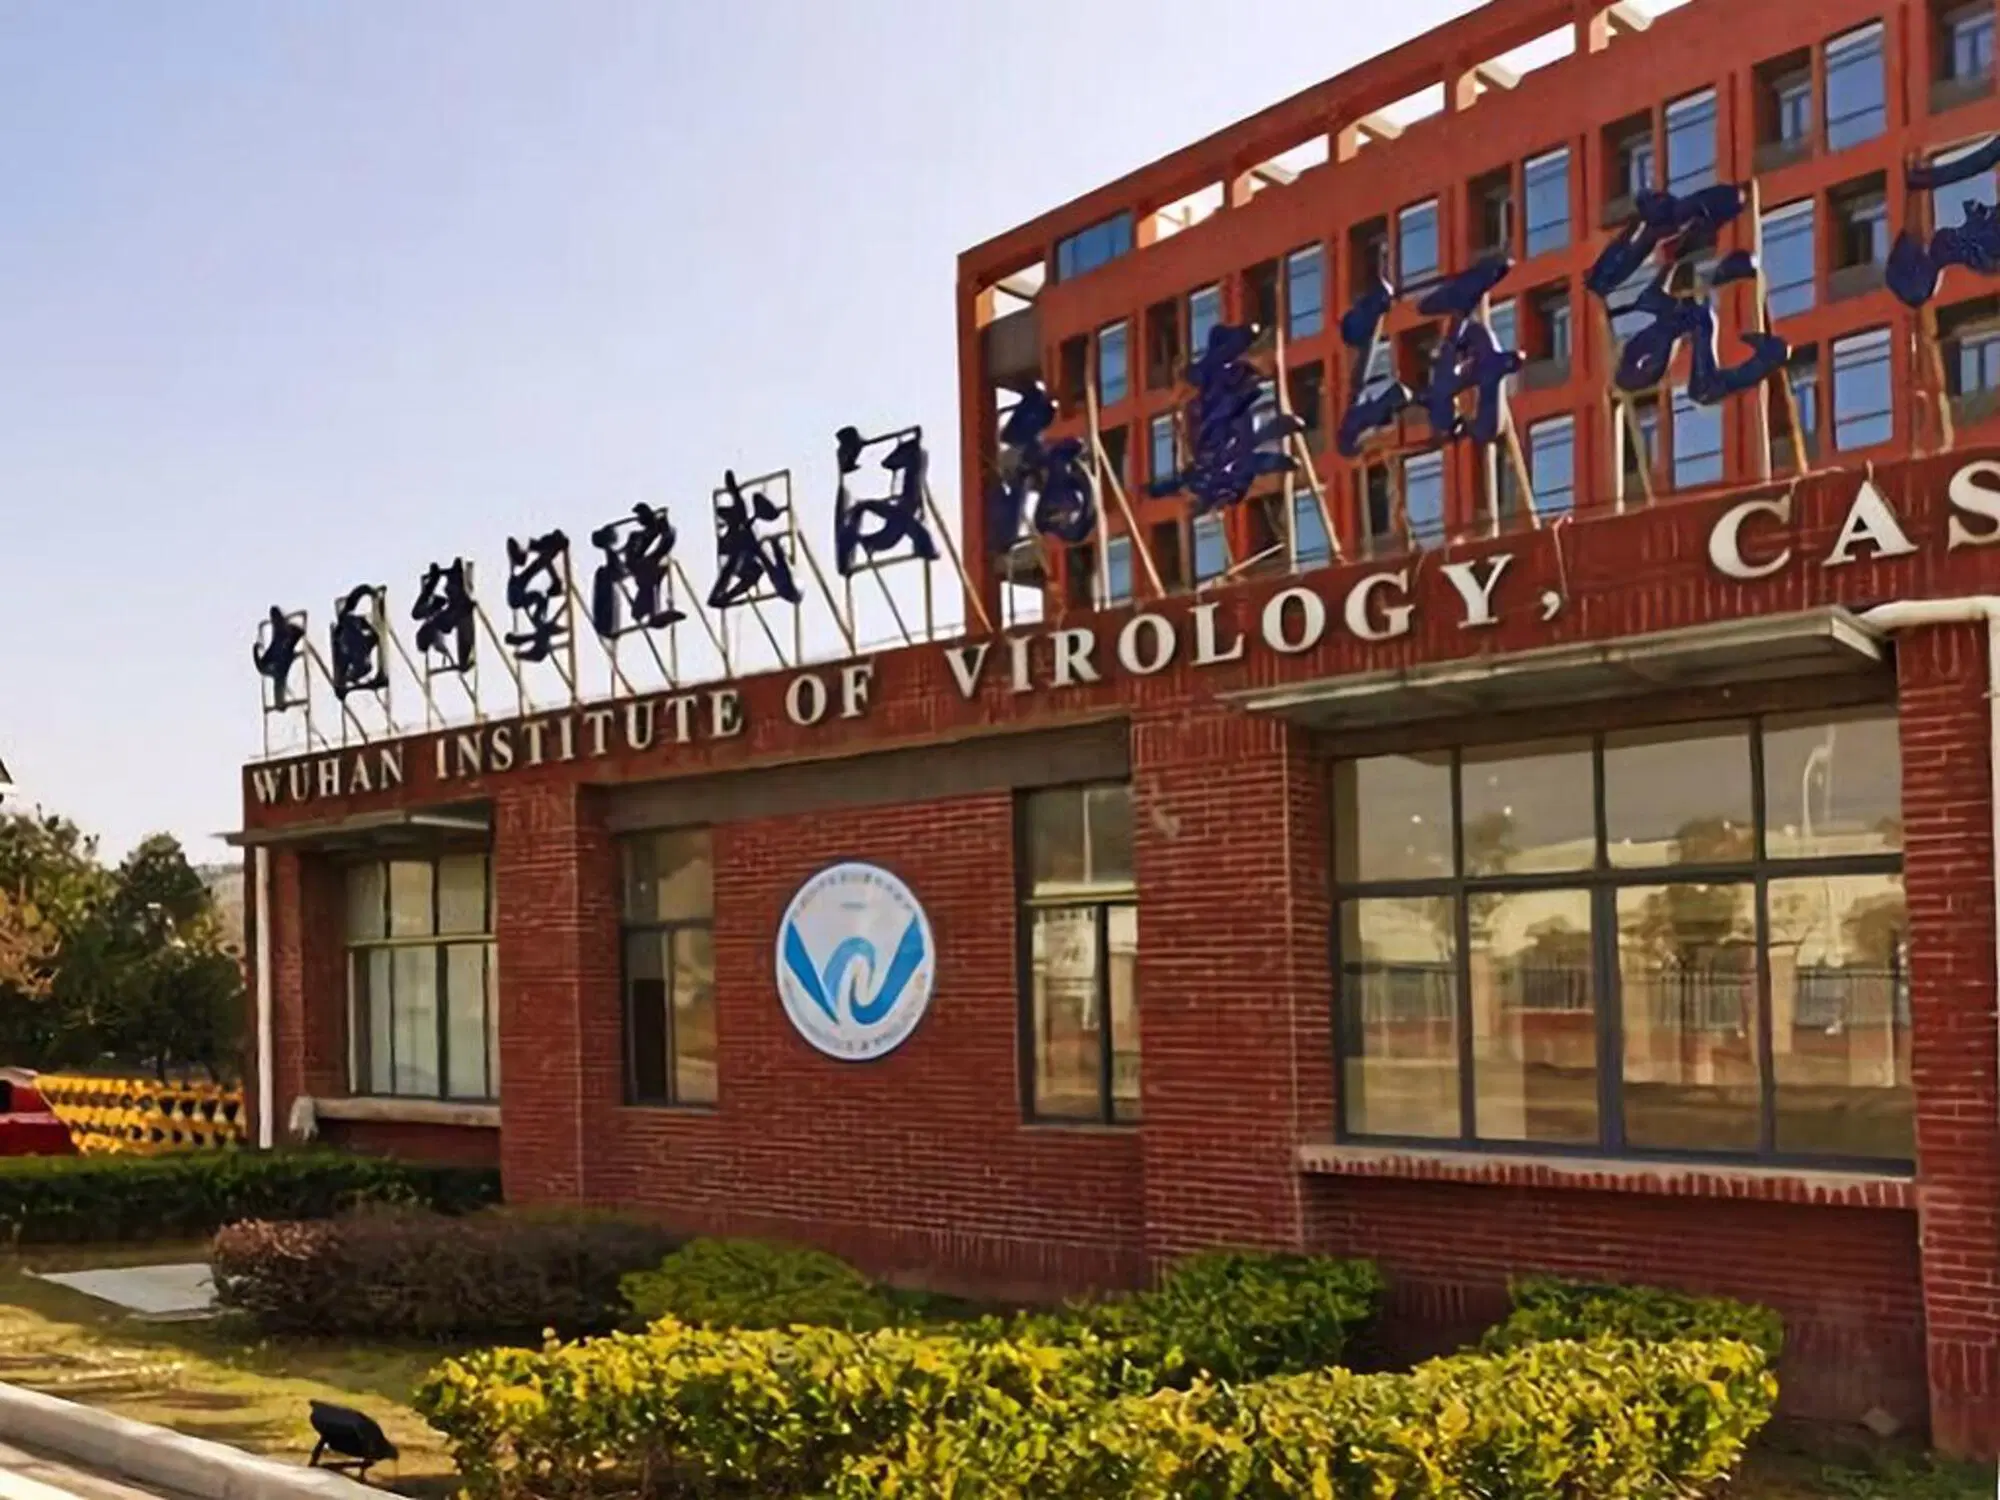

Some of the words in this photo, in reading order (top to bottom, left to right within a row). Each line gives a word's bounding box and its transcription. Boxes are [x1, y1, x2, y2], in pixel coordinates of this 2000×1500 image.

[252, 745, 404, 805] WUHAN
[435, 688, 744, 781] INSTITUTE
[785, 663, 876, 726] OF
[944, 552, 1562, 699] VIROLOGY,
[1708, 458, 2000, 580] CAS
